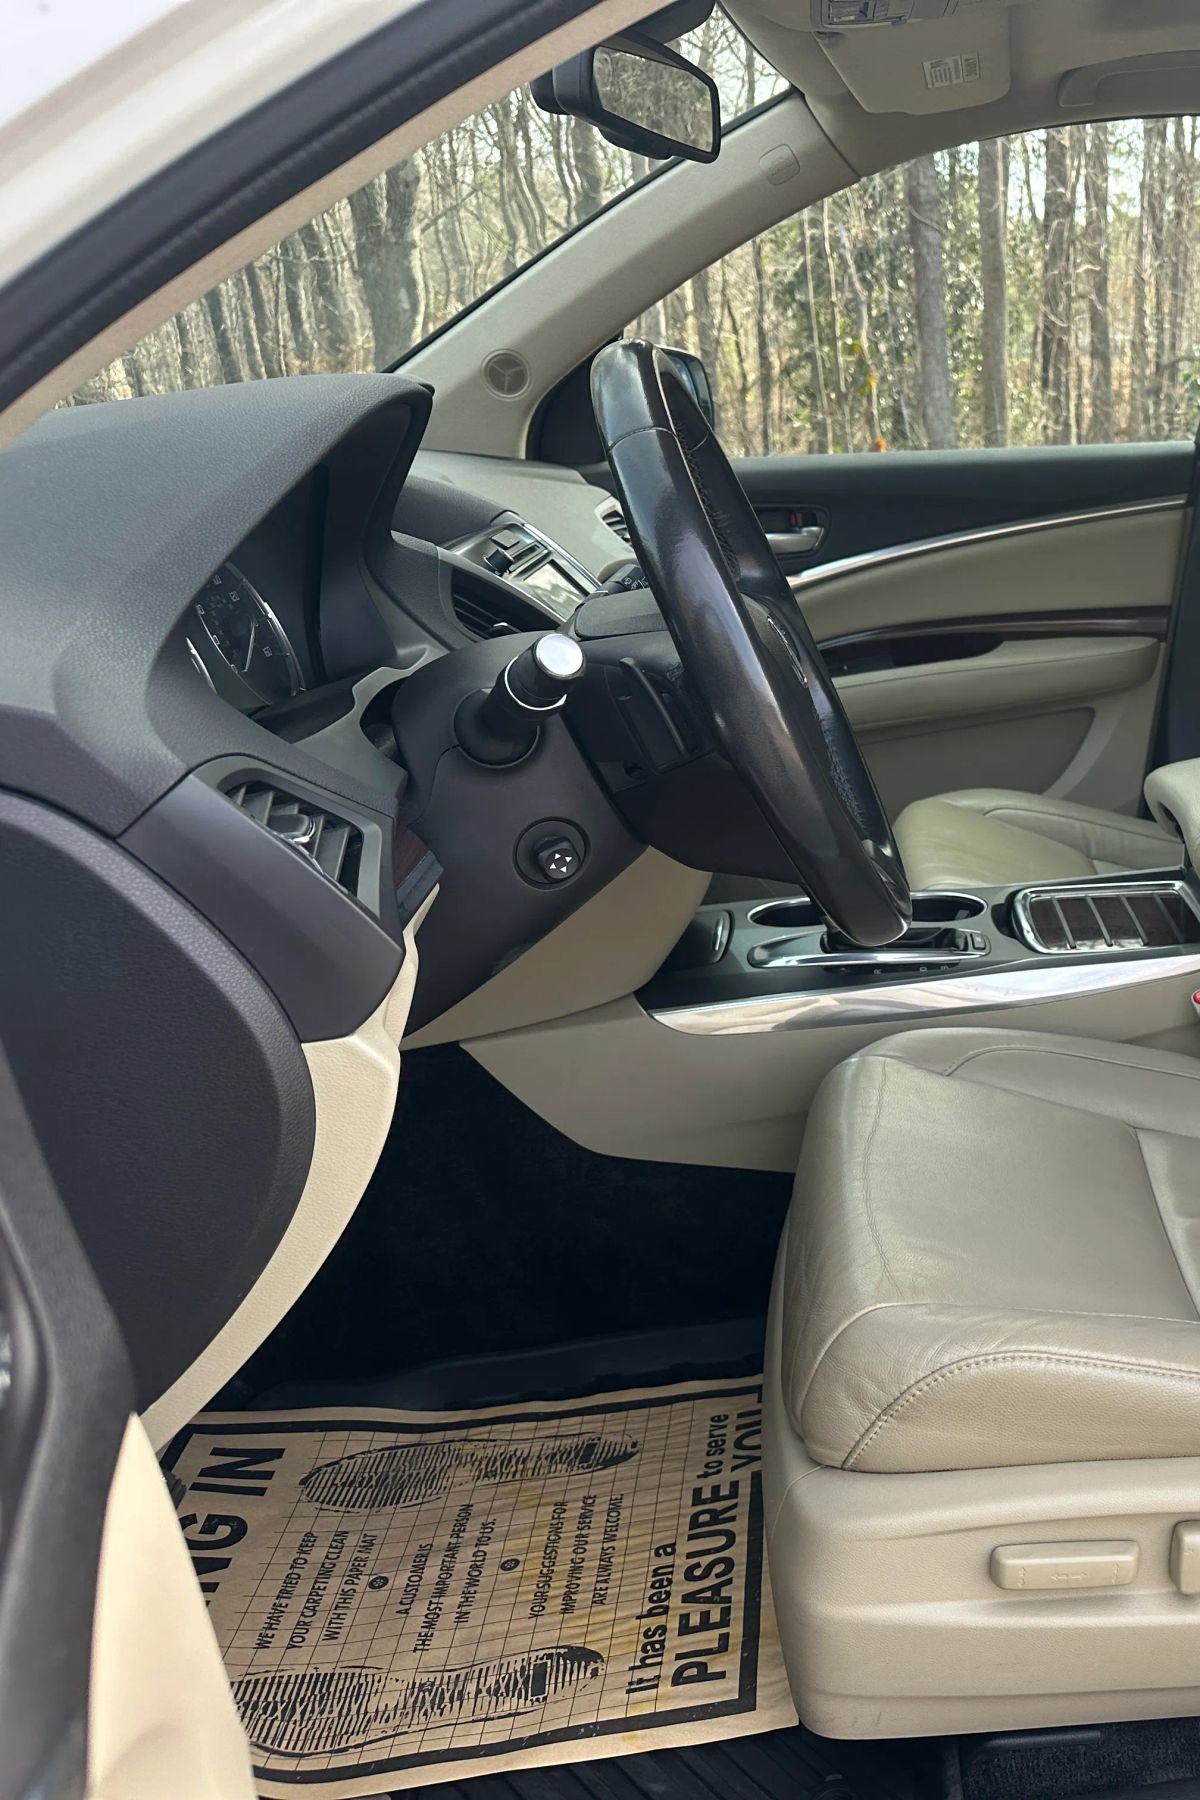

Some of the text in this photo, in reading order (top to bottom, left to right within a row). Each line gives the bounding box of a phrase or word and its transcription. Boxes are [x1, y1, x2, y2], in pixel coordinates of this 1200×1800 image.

[188, 1447, 286, 1496] IN
[253, 1532, 318, 1649] WE HAVE TRIED TO KEEP
[286, 1531, 349, 1649] YOUR CARPETING CLEAN
[322, 1534, 377, 1641] WITH THIS PAPER MAT
[399, 1553, 428, 1605] CUSTOMER
[418, 1544, 433, 1552] IS
[413, 1504, 473, 1653] THE MOST IMPORTANT PERSON
[454, 1519, 496, 1623] IN THE WORLD TO US.
[528, 1502, 568, 1619] YOUR SUGGESTIONS FOR
[560, 1495, 597, 1614] IMPROVING OUR SERVICE
[592, 1494, 623, 1605] ARE ALWAYS WELCOME.
[671, 1415, 739, 1687] PLEASURE to serve
[626, 1542, 675, 1694] It has been a
